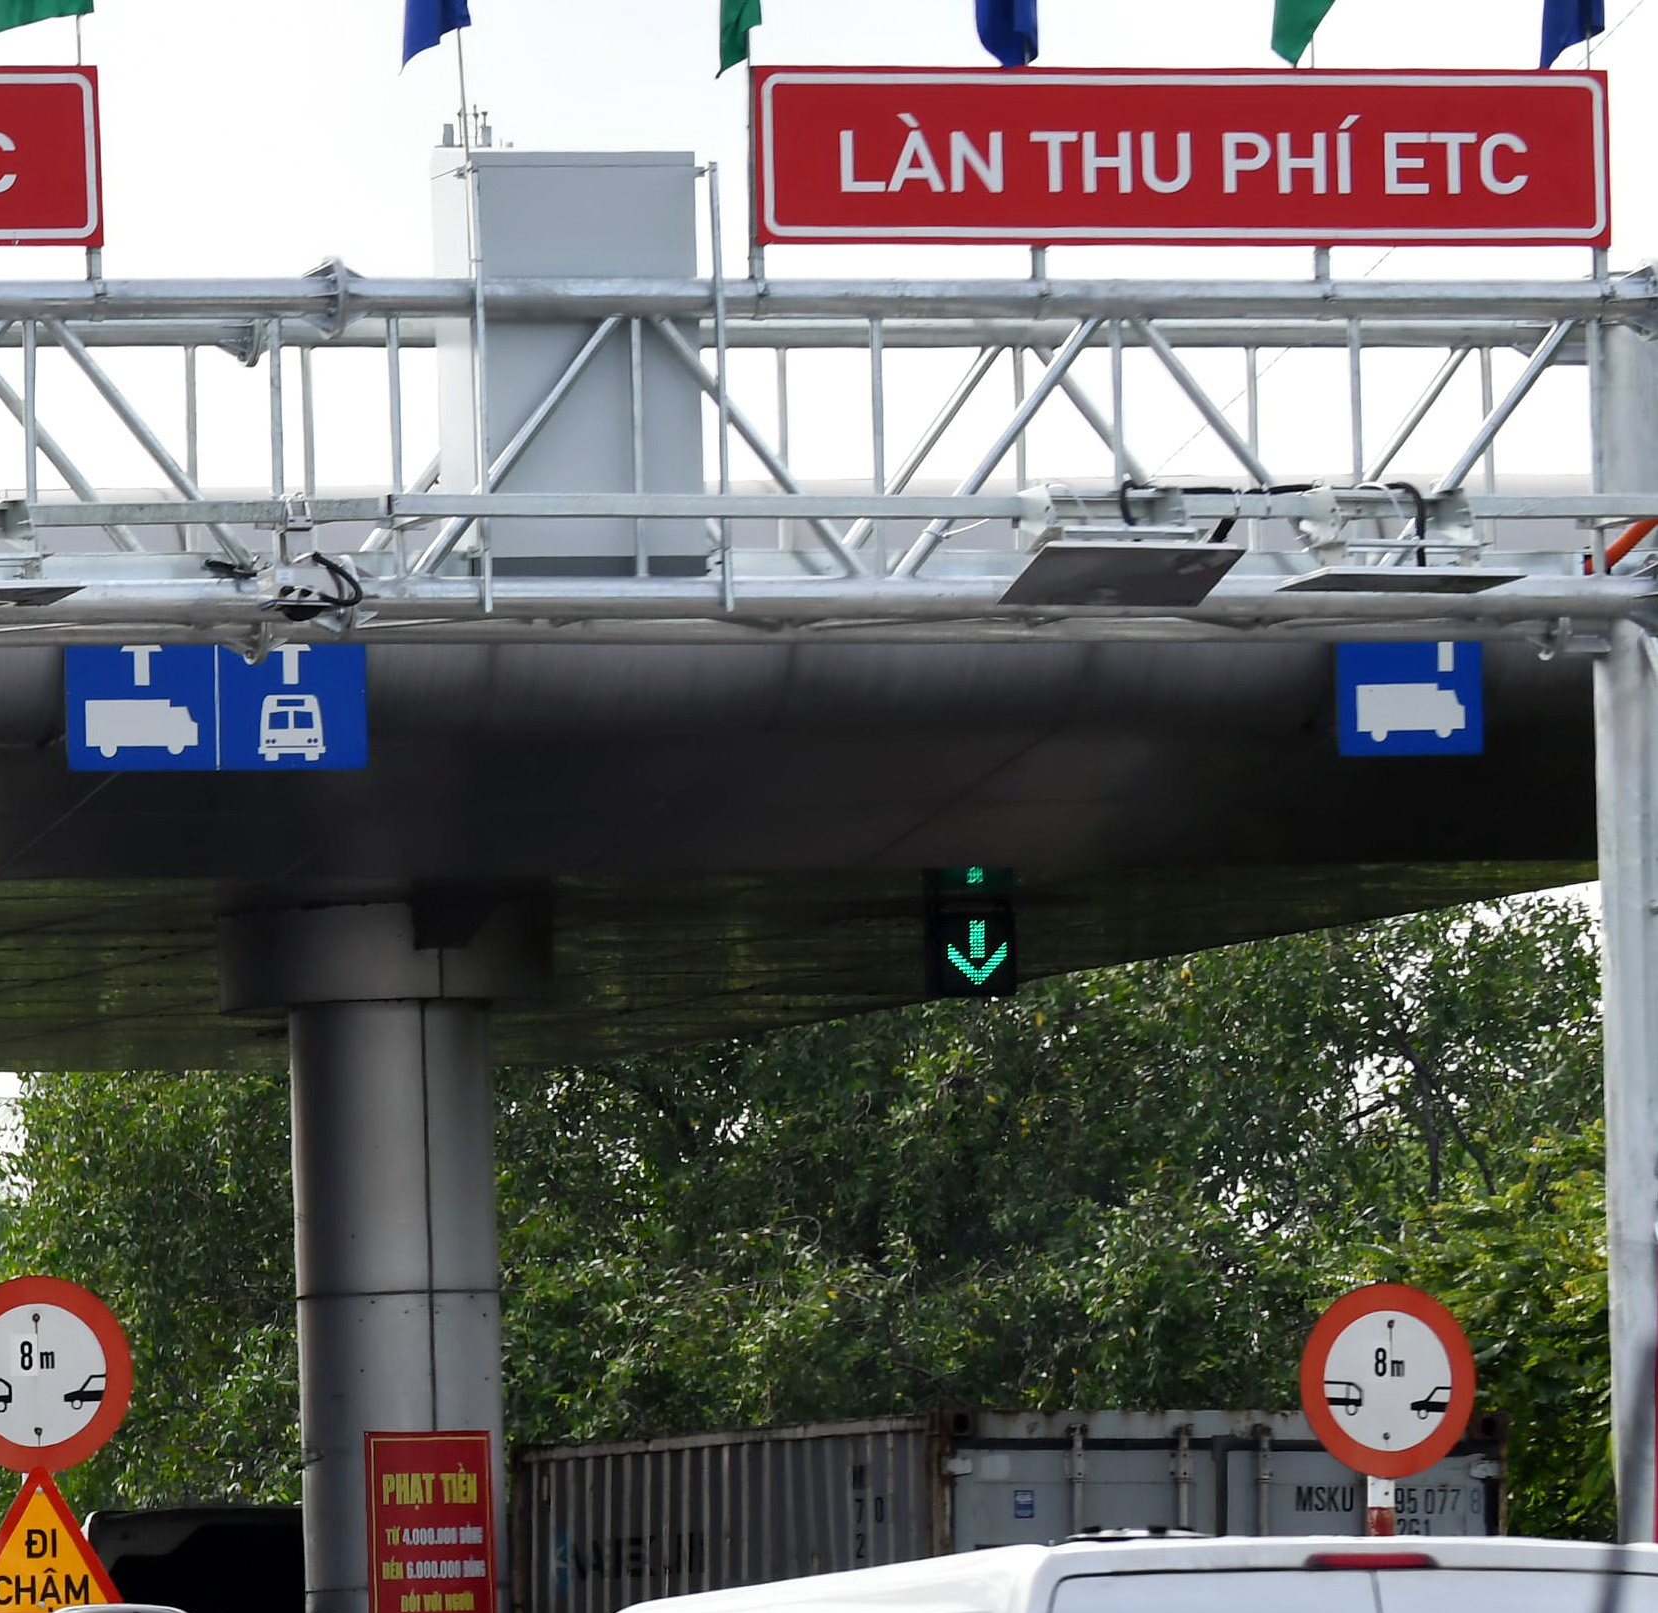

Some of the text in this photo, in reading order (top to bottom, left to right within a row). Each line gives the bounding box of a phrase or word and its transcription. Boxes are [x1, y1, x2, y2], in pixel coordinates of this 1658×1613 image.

[839, 114, 1530, 195] LÀN THU PHÍ ETC
[383, 1462, 478, 1510] PHẠT TIỀN
[1295, 1486, 1355, 1512] MSKU
[1394, 1488, 1418, 1514] 95
[25, 1529, 56, 1558] ĐI
[406, 1560, 461, 1579] 6.000.000
